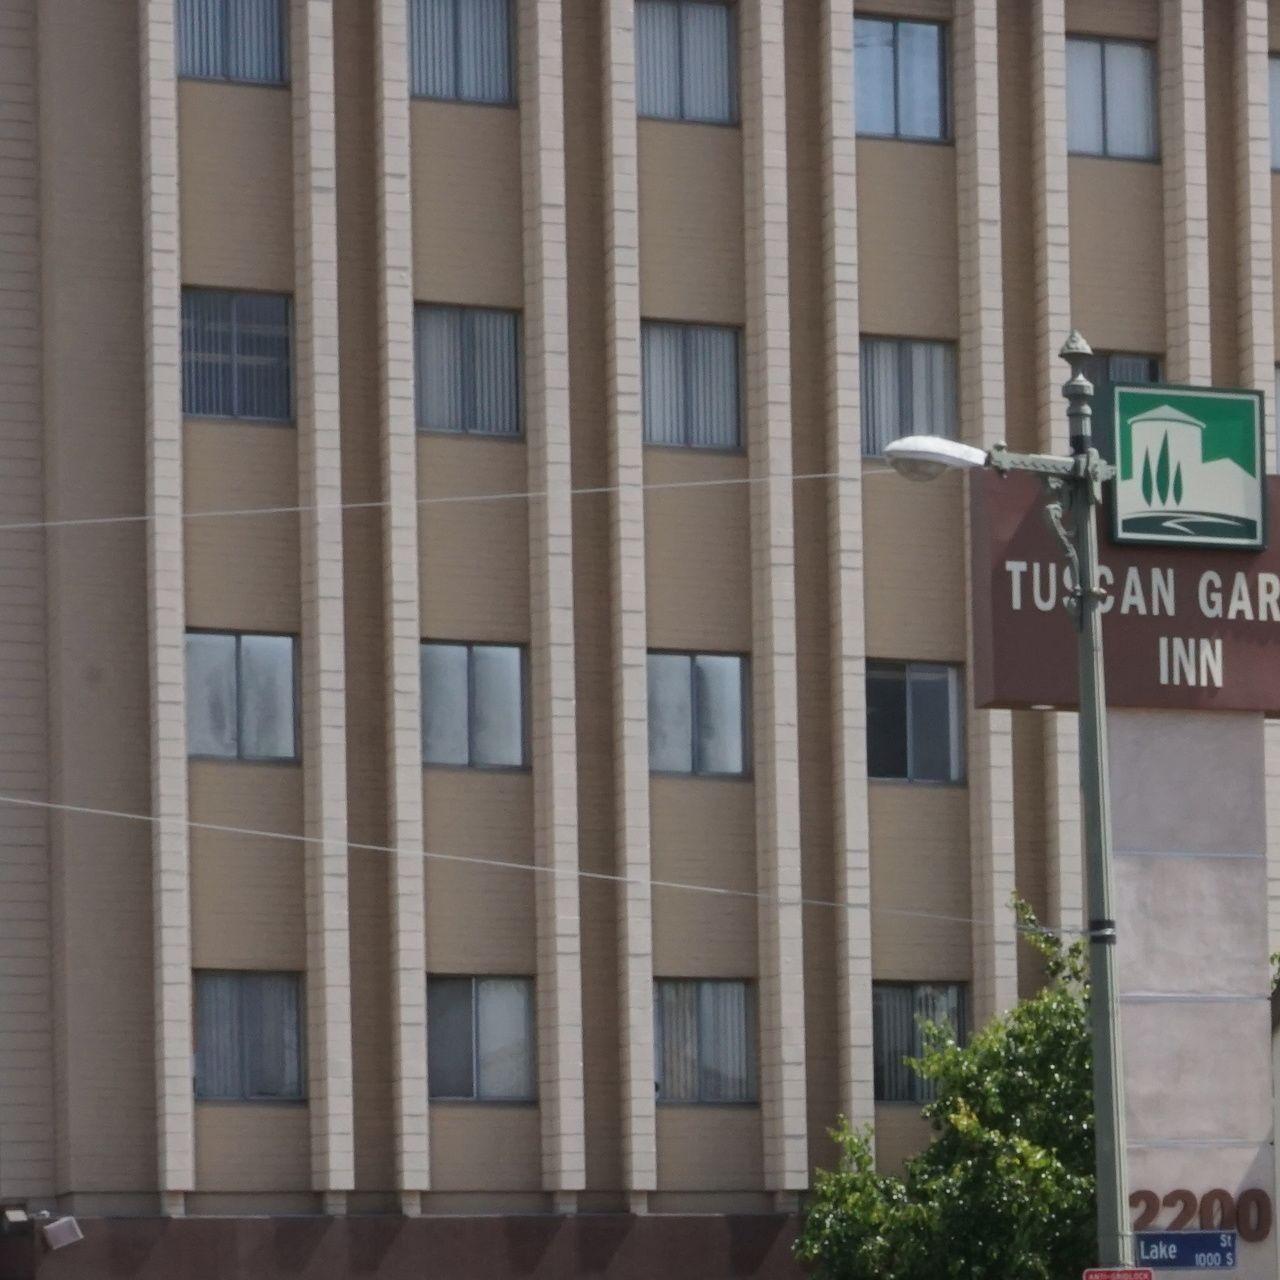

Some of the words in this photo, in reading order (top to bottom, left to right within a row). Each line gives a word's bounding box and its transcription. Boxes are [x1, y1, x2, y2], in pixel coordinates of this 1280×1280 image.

[1158, 637, 1224, 688] INN
[1128, 1188, 1272, 1243] 2200
[1140, 1241, 1177, 1260] Lake
[1219, 1233, 1232, 1248] St
[1195, 1253, 1221, 1267] 1000
[1225, 1252, 1234, 1266] S
